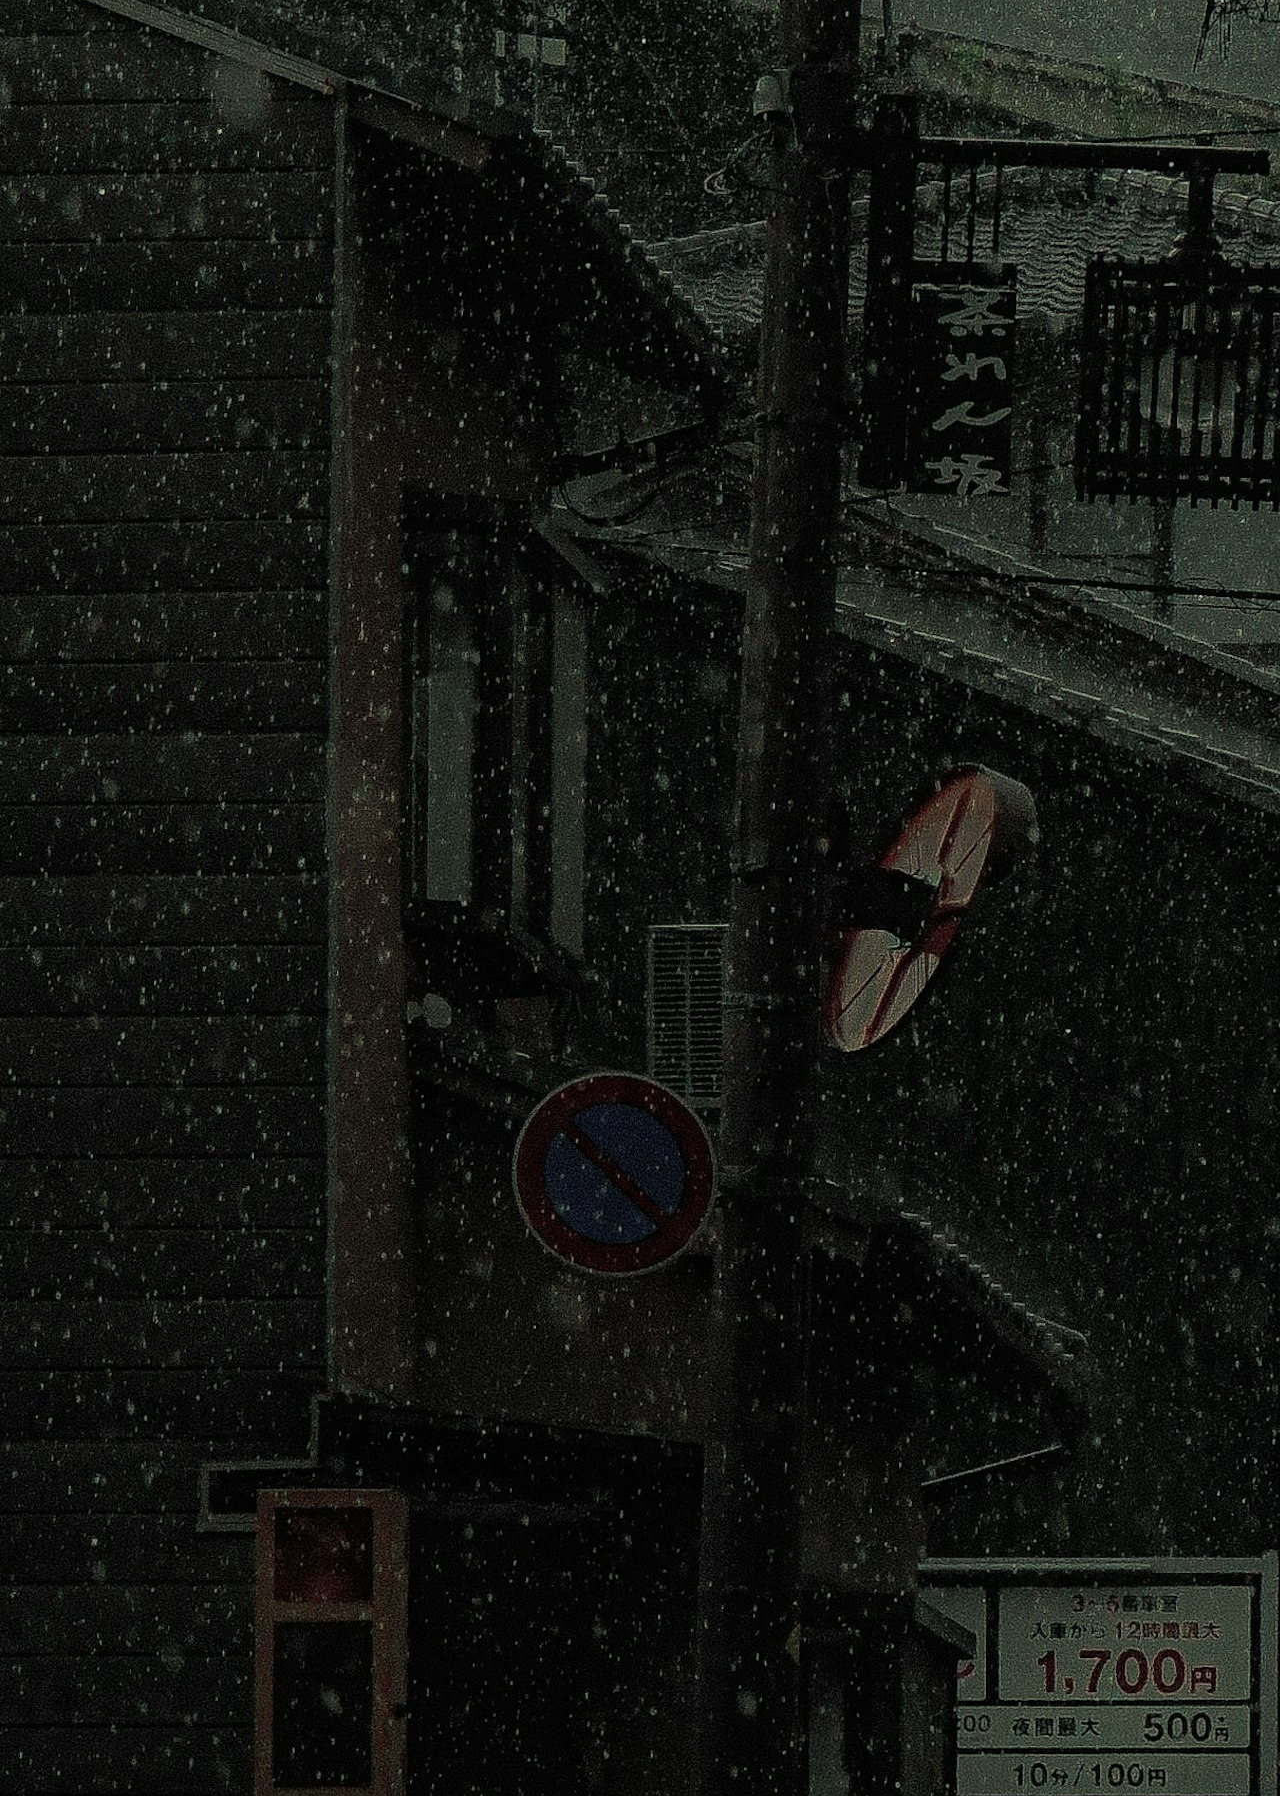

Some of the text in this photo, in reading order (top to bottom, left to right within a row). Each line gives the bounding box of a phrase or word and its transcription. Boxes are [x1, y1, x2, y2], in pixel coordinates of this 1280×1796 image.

[924, 290, 1015, 496] 茶わん坂
[1029, 1621, 1106, 1640] 入庫から
[1037, 1648, 1218, 1696] 1,700円
[1011, 1717, 1101, 1737] 夜間最大
